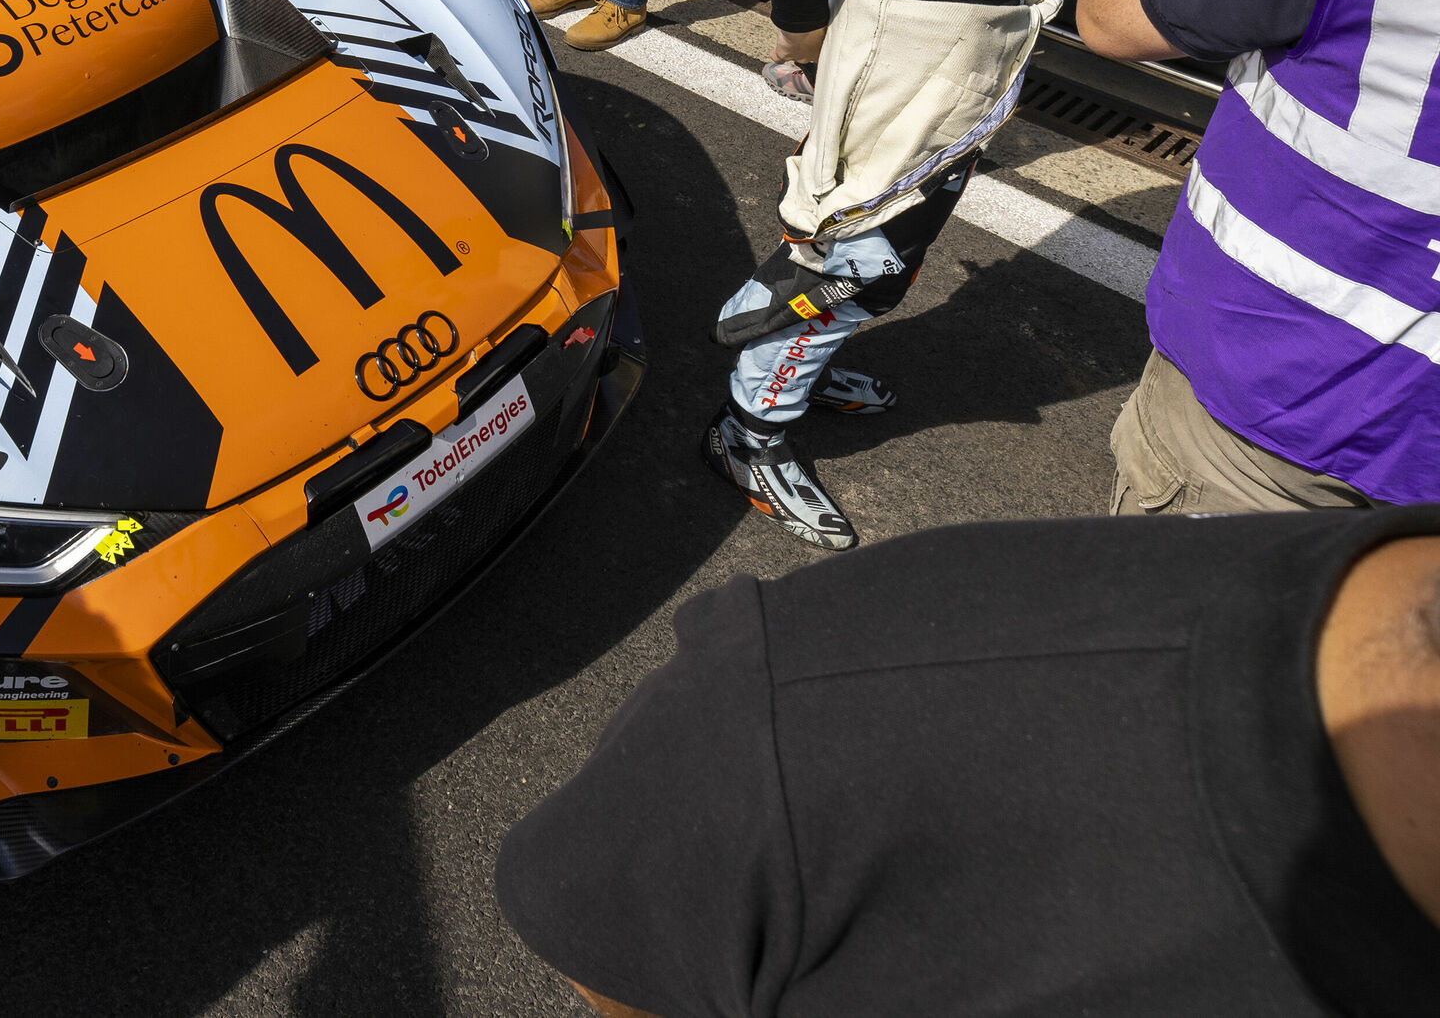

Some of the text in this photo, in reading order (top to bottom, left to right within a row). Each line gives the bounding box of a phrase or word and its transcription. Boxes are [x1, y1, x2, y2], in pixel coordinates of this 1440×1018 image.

[785, 323, 821, 362] Audi
[761, 364, 797, 408] Sport
[412, 394, 527, 492] TotalEnergies
[710, 427, 723, 455] OMP
